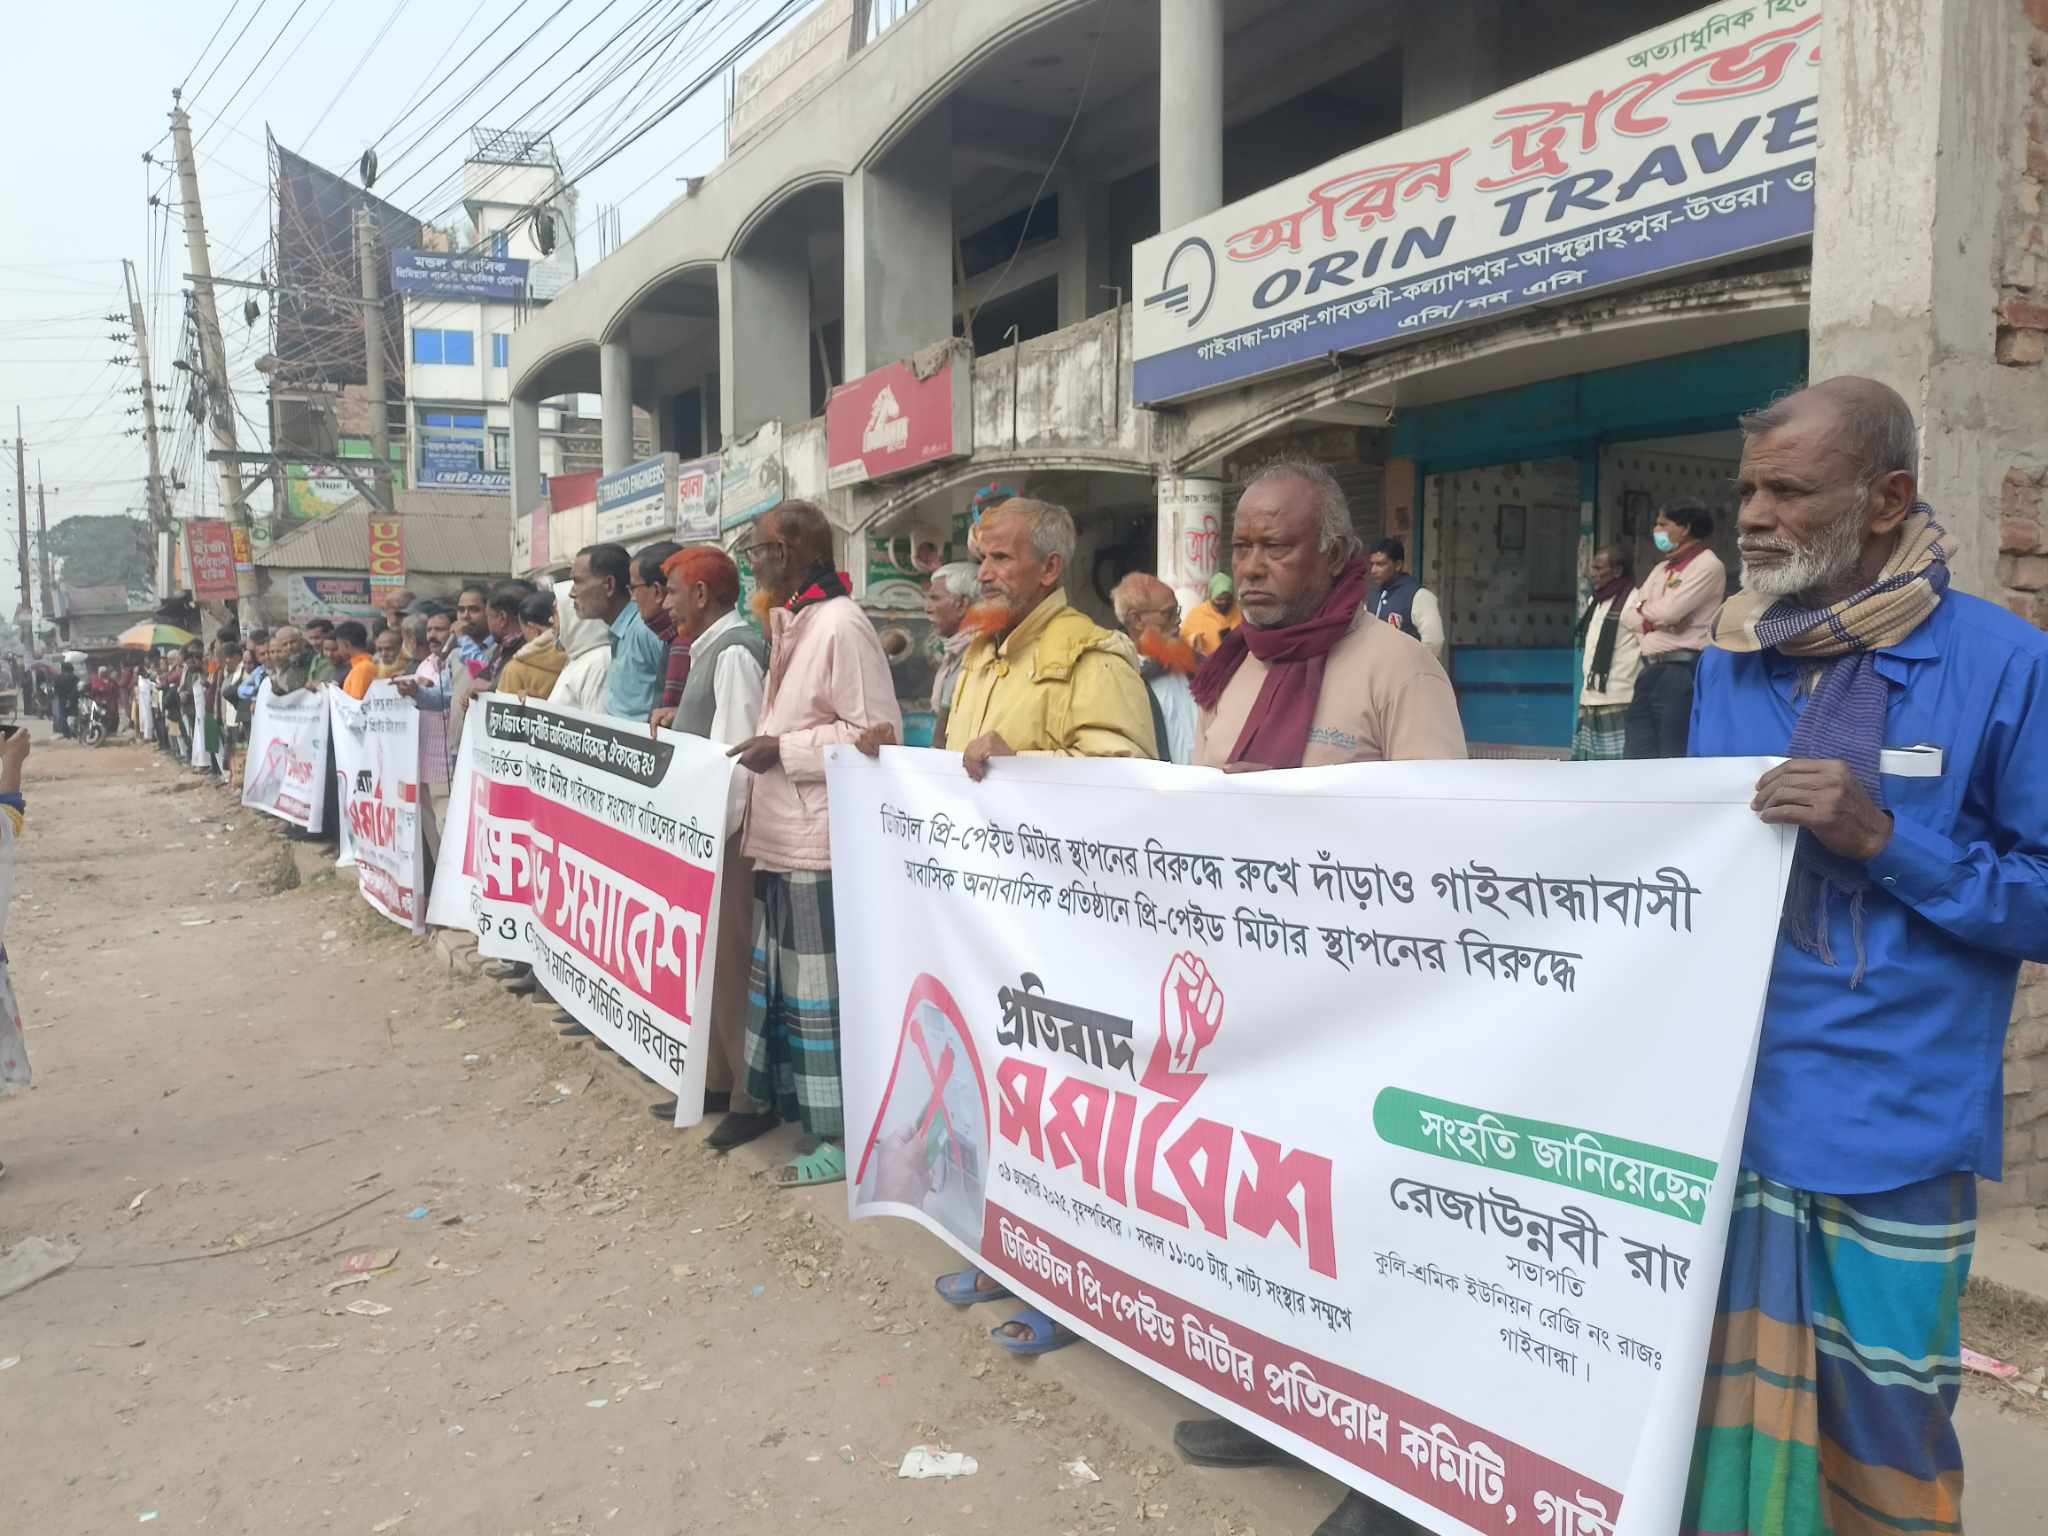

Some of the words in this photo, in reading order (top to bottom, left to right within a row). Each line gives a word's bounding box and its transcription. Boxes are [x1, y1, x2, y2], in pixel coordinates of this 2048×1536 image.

[1626, 6, 1757, 68] অত্যাধুনিক
[1225, 147, 1471, 262] অরিন
[1475, 13, 1822, 190] ট্রাভে
[1252, 215, 1458, 310] ORIN
[1522, 268, 1590, 295] এসি
[371, 522, 402, 575] UCC
[638, 801, 678, 844] বাতিলের
[680, 815, 716, 859] দাবীতে
[928, 812, 1015, 860] প্রি-পেইড
[1017, 822, 1063, 865] মিটার
[1066, 836, 1139, 877] স্থাপনের
[1145, 838, 1225, 890] বিরুদ্ধে
[1232, 856, 1302, 899] রুখে
[1308, 849, 1415, 911] দাঁড়াও
[1430, 858, 1702, 933] গাইবান্ধাবাসী
[904, 857, 959, 892] আবাসিক
[963, 871, 1053, 910] অনাবাসিক
[1057, 880, 1130, 925] প্রতিষ্ঠানে
[1134, 889, 1225, 946] প্রি-পেইড
[1232, 905, 1310, 957] মিটার
[1316, 924, 1448, 973] স্থাপনের
[1455, 927, 1584, 993] বিরুদ্ধে
[551, 951, 588, 999] মালিক
[587, 976, 624, 1030] সমিতি
[996, 971, 1137, 1083] প্রতিবাদ
[995, 1055, 1338, 1281] সমাবেশ
[1418, 1108, 1521, 1165] সংহতি
[1135, 1226, 1166, 1257] সকাল
[1390, 1177, 1609, 1270] রেজাউন্নবী
[1465, 1273, 1532, 1321] ইউনিয়ন
[1539, 1307, 1582, 1340] রেজি
[1586, 1323, 1613, 1354] নং
[1505, 1254, 1586, 1298] সভাপতি
[999, 1215, 1074, 1297] ডিজিটাল
[1075, 1260, 1177, 1348] প্রি-পেইড
[1182, 1313, 1255, 1392] মিটার
[1263, 1361, 1390, 1456] প্রতিরোধ
[1498, 1326, 1578, 1378] গাইবান্ধা
